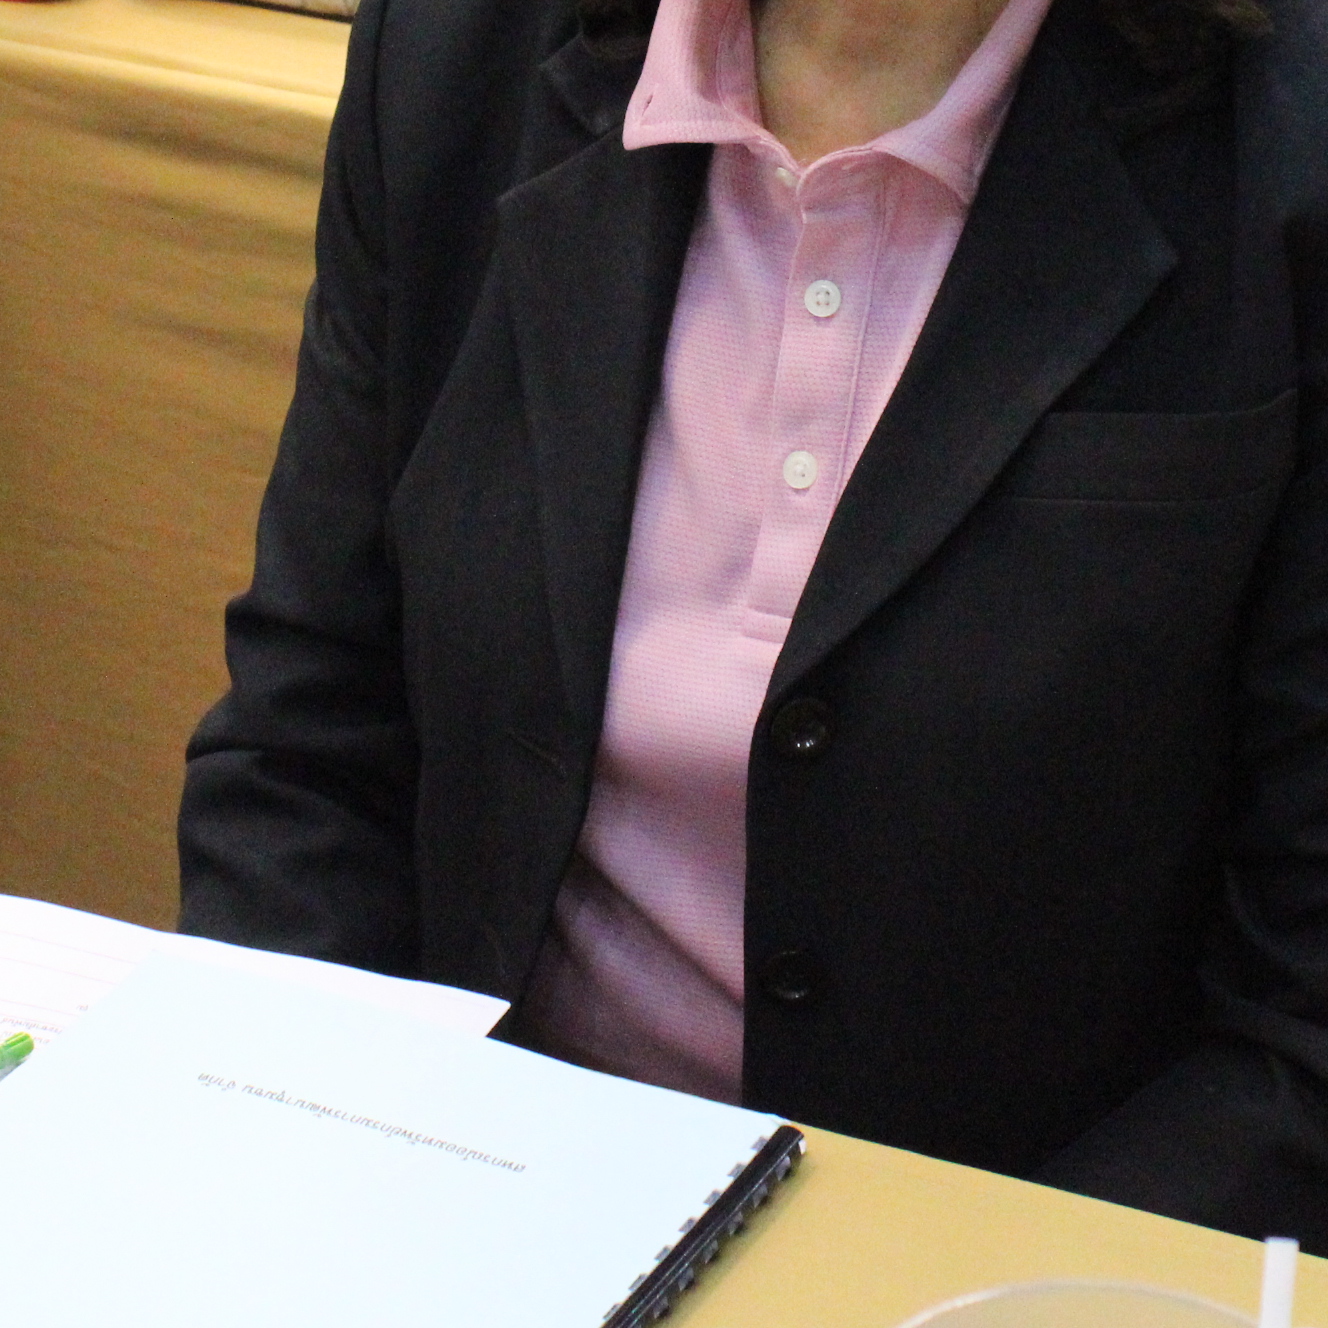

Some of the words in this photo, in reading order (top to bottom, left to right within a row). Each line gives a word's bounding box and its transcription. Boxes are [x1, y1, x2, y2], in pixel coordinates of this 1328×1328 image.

[196, 1072, 237, 1091] จำกัด
[242, 1083, 527, 1173] สหกรณ์ออมทรัพย์กรมการพัฒนาชุมชน
